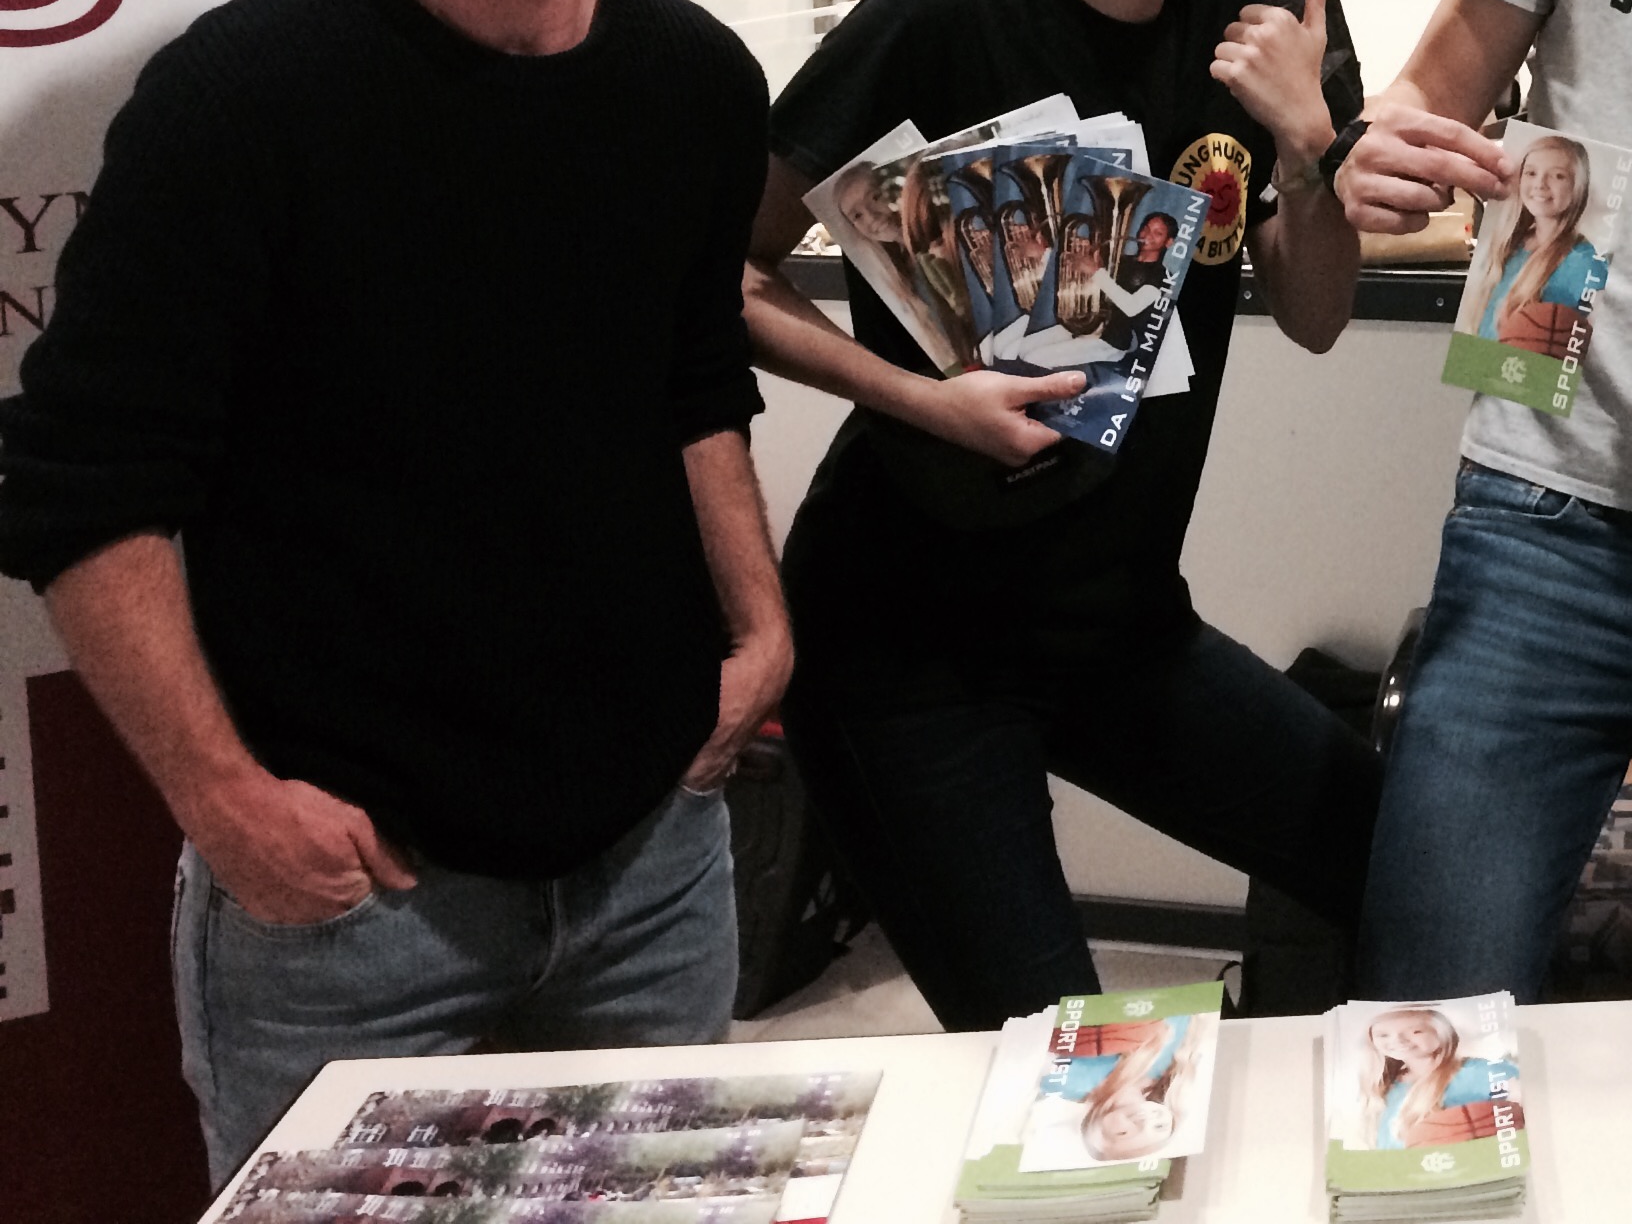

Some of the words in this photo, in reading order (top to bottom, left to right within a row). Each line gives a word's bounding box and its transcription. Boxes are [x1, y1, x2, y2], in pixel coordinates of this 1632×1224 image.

[1175, 144, 1210, 188] UNG
[1552, 319, 1587, 410] SPORT
[1578, 269, 1600, 313] IST
[1592, 156, 1632, 262] KLASSE
[1100, 412, 1128, 447] DA
[1120, 358, 1147, 403] IST
[1139, 267, 1180, 353] MUSIK
[1171, 195, 1205, 259] DRIN
[1056, 998, 1085, 1053] SPORT
[1048, 1057, 1072, 1086] IST
[1488, 1071, 1509, 1099] IST
[1492, 1105, 1521, 1169] SPORT
